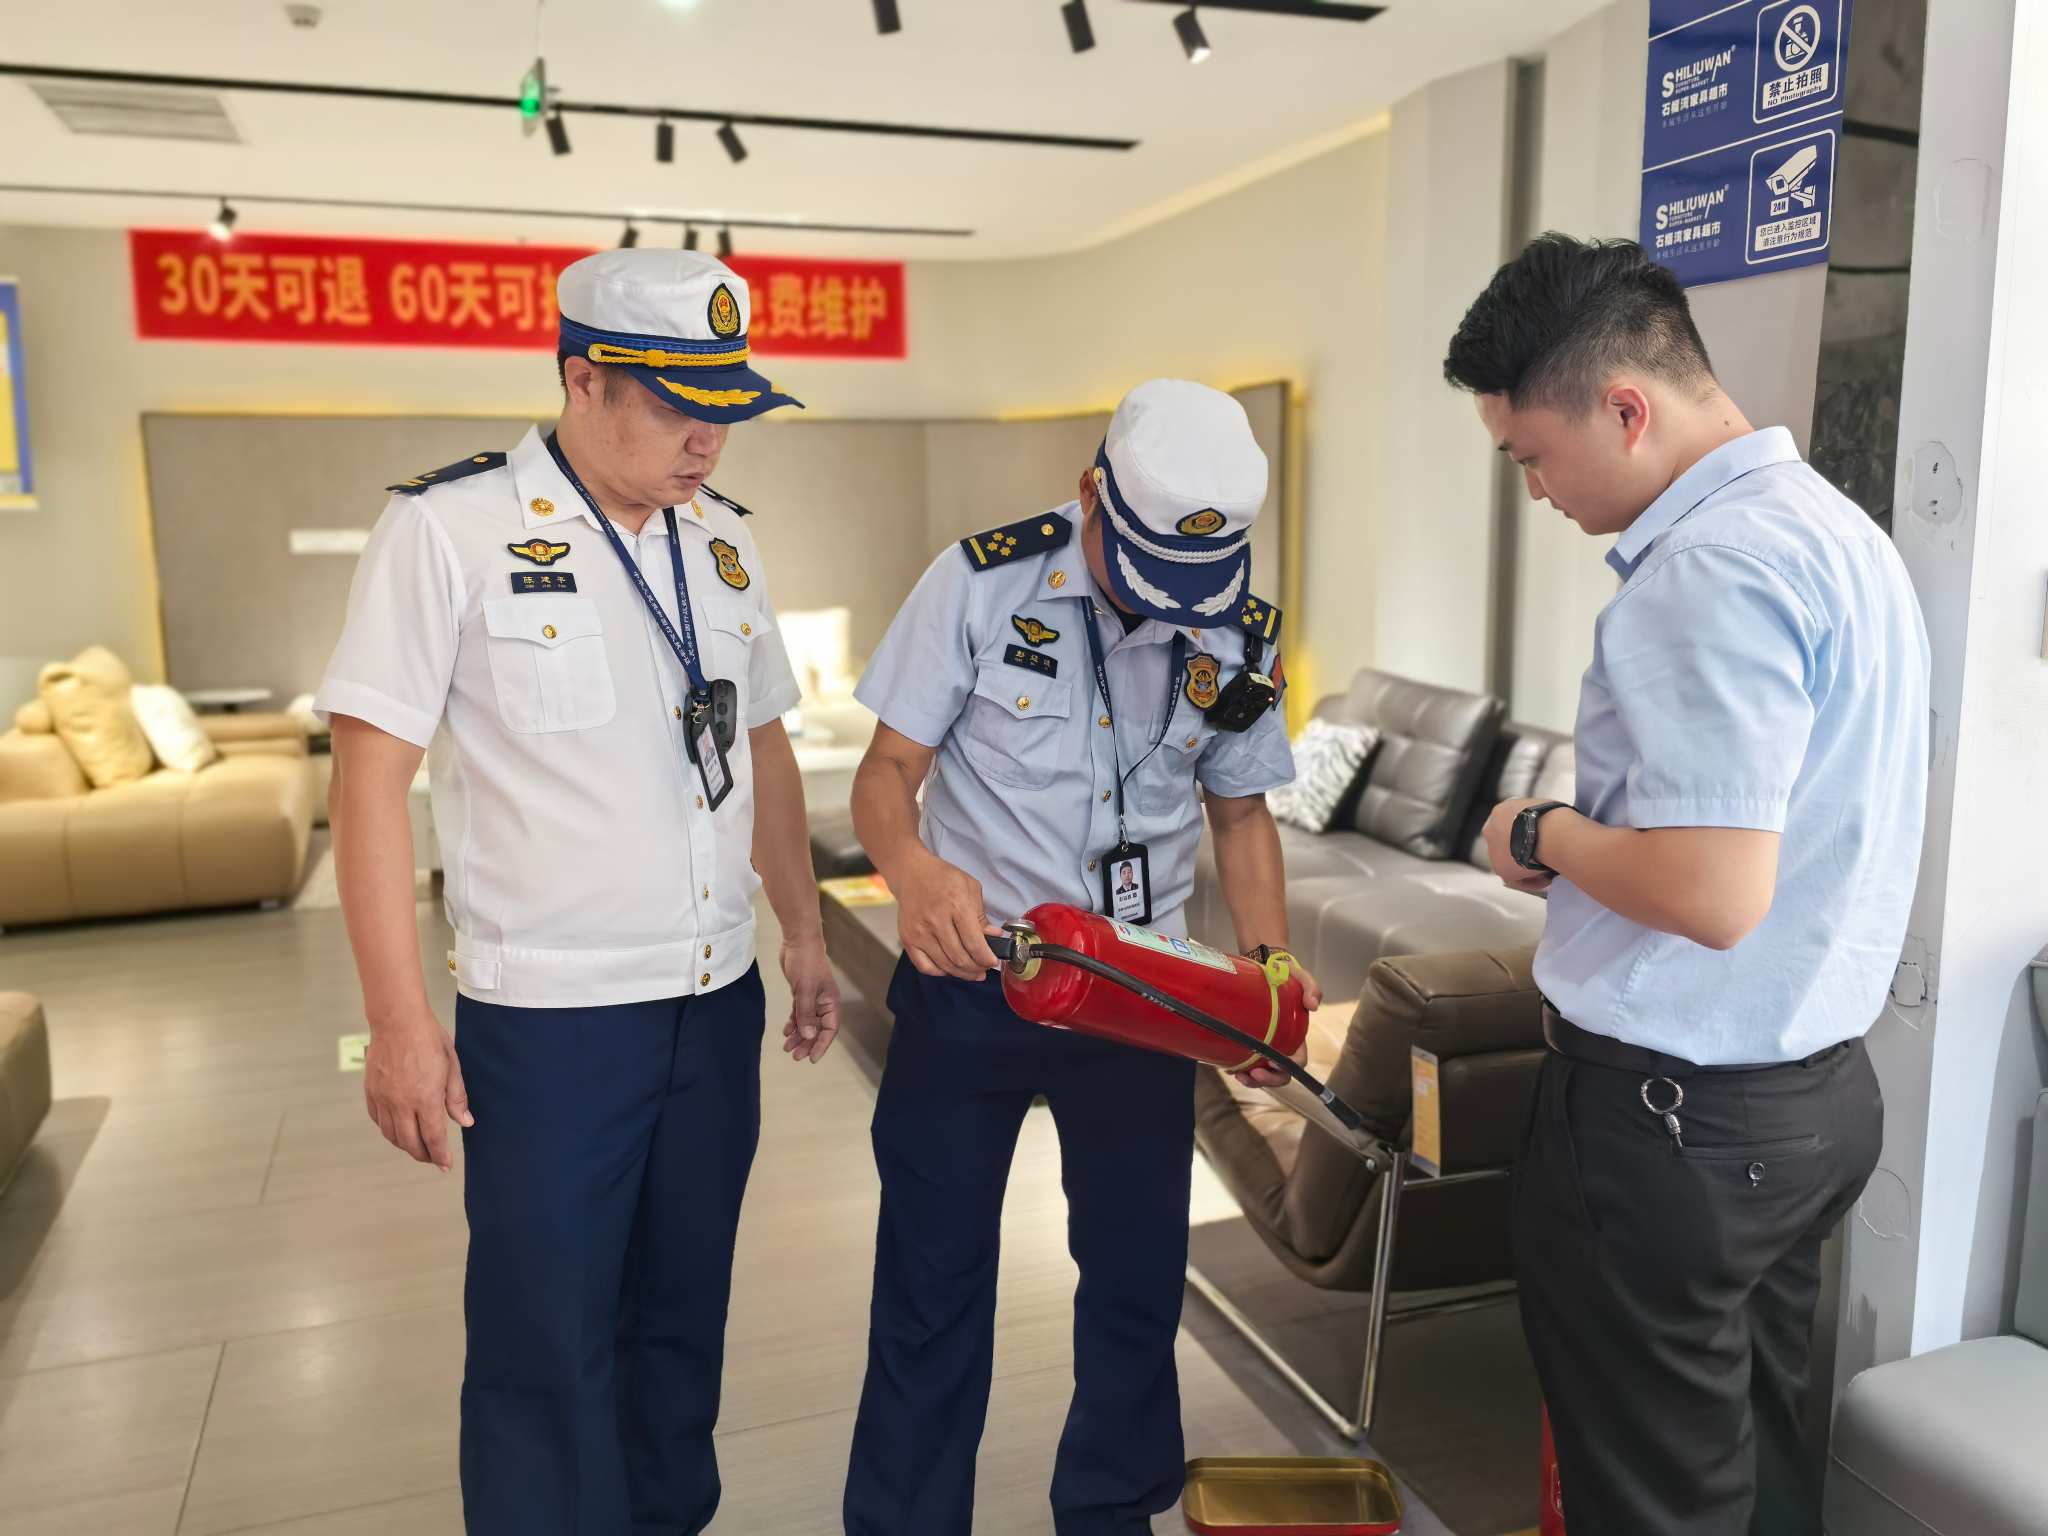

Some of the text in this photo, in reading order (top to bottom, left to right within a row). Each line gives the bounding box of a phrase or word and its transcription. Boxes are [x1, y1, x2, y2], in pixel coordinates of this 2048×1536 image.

[1662, 50, 1731, 98] SHILIUWAN
[1769, 67, 1822, 98] 禁止拍照
[1767, 99, 1778, 107] NO
[1656, 189, 1724, 230] SHILIUWAN
[157, 253, 371, 325] 30天可退
